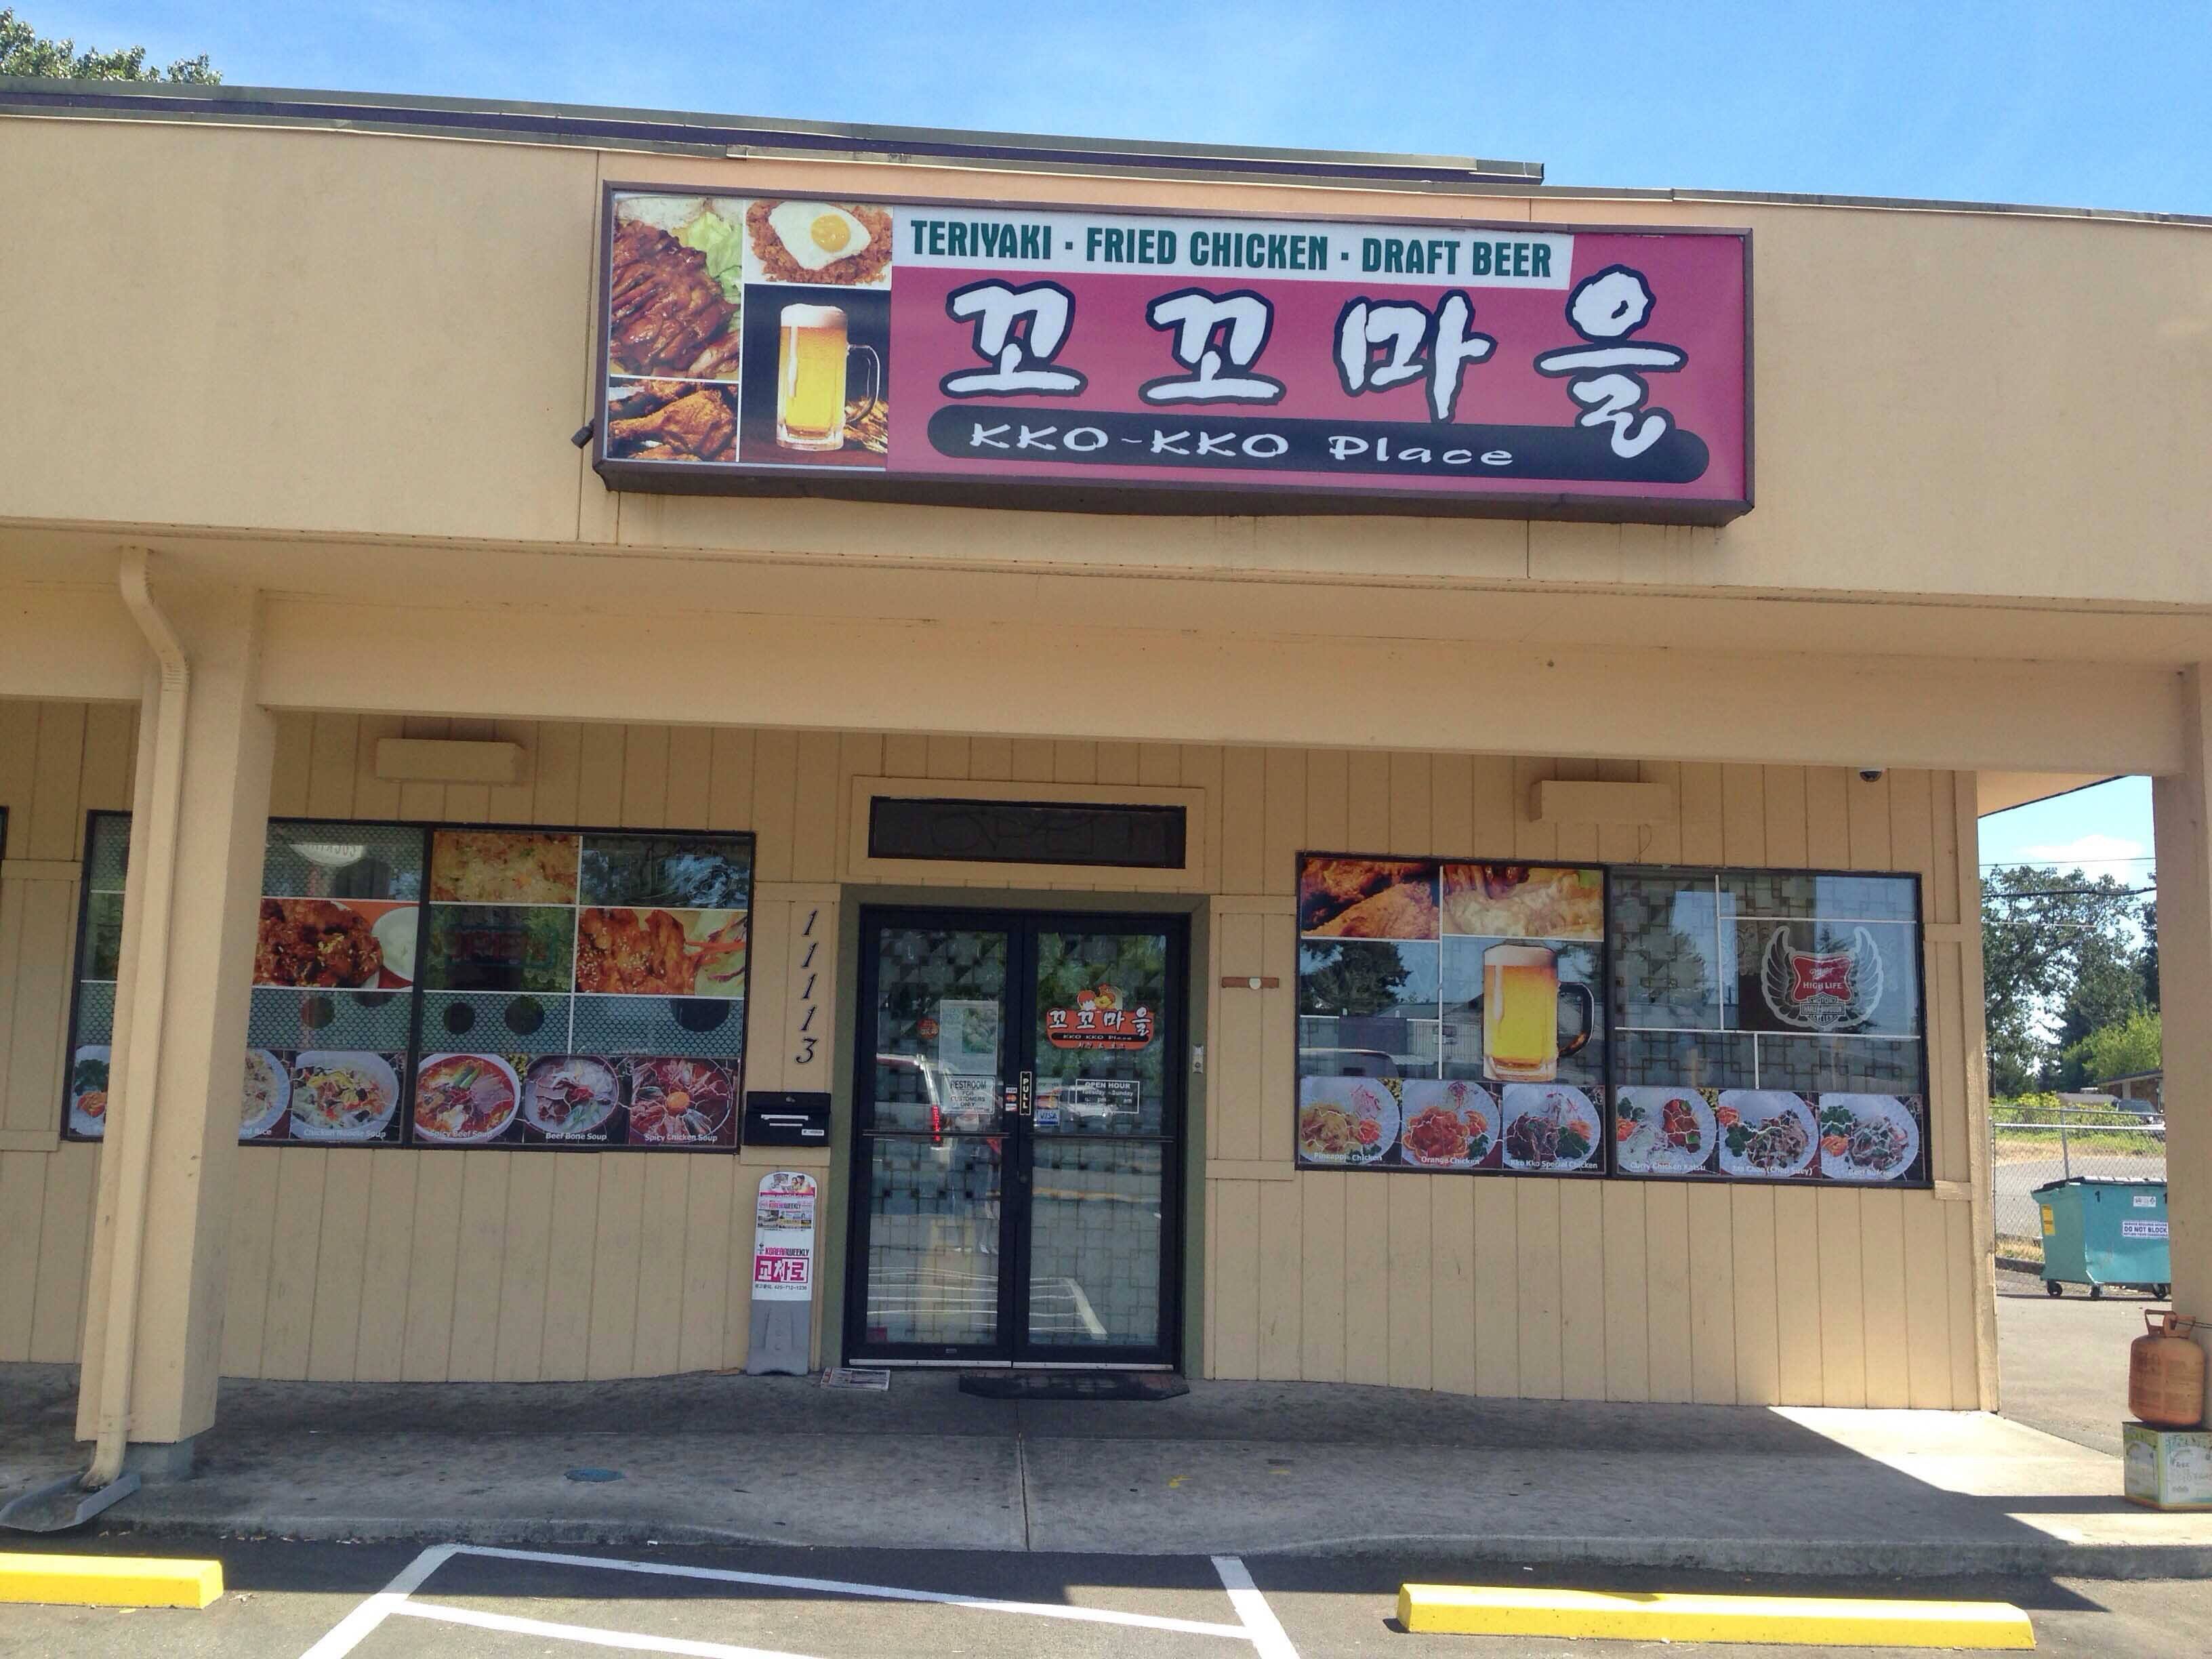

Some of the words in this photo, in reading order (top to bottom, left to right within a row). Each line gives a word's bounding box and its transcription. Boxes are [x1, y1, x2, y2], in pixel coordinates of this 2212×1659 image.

[911, 220, 1051, 260] TERIYAKI
[1087, 227, 1176, 264] FRIED
[1190, 230, 1328, 270] CHICKEN
[1362, 238, 1460, 274] DRAFT
[1472, 241, 1551, 277] BEER
[1328, 435, 1513, 466] Place
[950, 1080, 987, 1090] RESTROOM
[304, 1128, 335, 1136] Chicken
[366, 1130, 386, 1141] Soup
[474, 1130, 493, 1139] Soup
[586, 1133, 607, 1142] Soup
[644, 1134, 665, 1143] Spicy
[698, 1134, 718, 1144] Soup
[1352, 1153, 1382, 1162] Chicken
[1420, 1156, 1449, 1165] Orange
[1450, 1157, 1481, 1165] Chicken
[1568, 1161, 1598, 1170] Chicken
[1652, 1163, 1682, 1171] Chicken
